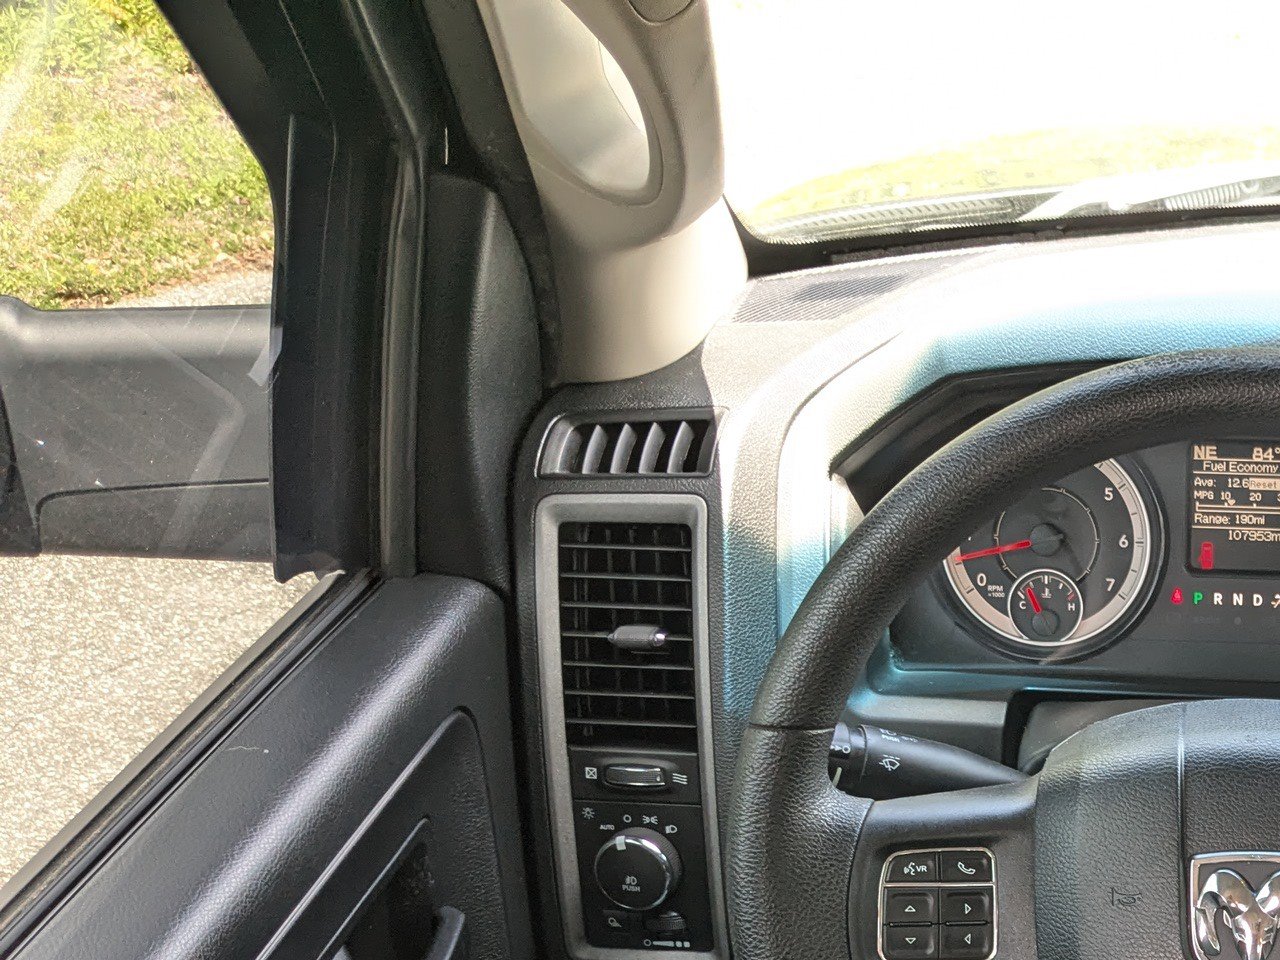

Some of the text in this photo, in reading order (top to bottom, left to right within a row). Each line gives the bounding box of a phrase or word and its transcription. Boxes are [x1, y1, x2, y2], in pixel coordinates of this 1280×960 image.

[1194, 446, 1218, 460] NE
[1203, 462, 1278, 473] Fuel Economy
[1228, 478, 1250, 488] 12.6
[1251, 480, 1278, 488] Reset
[1104, 488, 1114, 500] 5
[1194, 491, 1214, 500] MPG
[1221, 492, 1232, 500] 10
[1250, 493, 1262, 502] 20
[1194, 514, 1231, 525] Range:
[1119, 534, 1128, 548] 6
[976, 573, 987, 586] 0
[1106, 578, 1116, 592] 7
[1194, 592, 1263, 606] P R N D
[1020, 601, 1026, 609] C
[1068, 603, 1076, 611] H
[622, 884, 640, 892] PUSH
